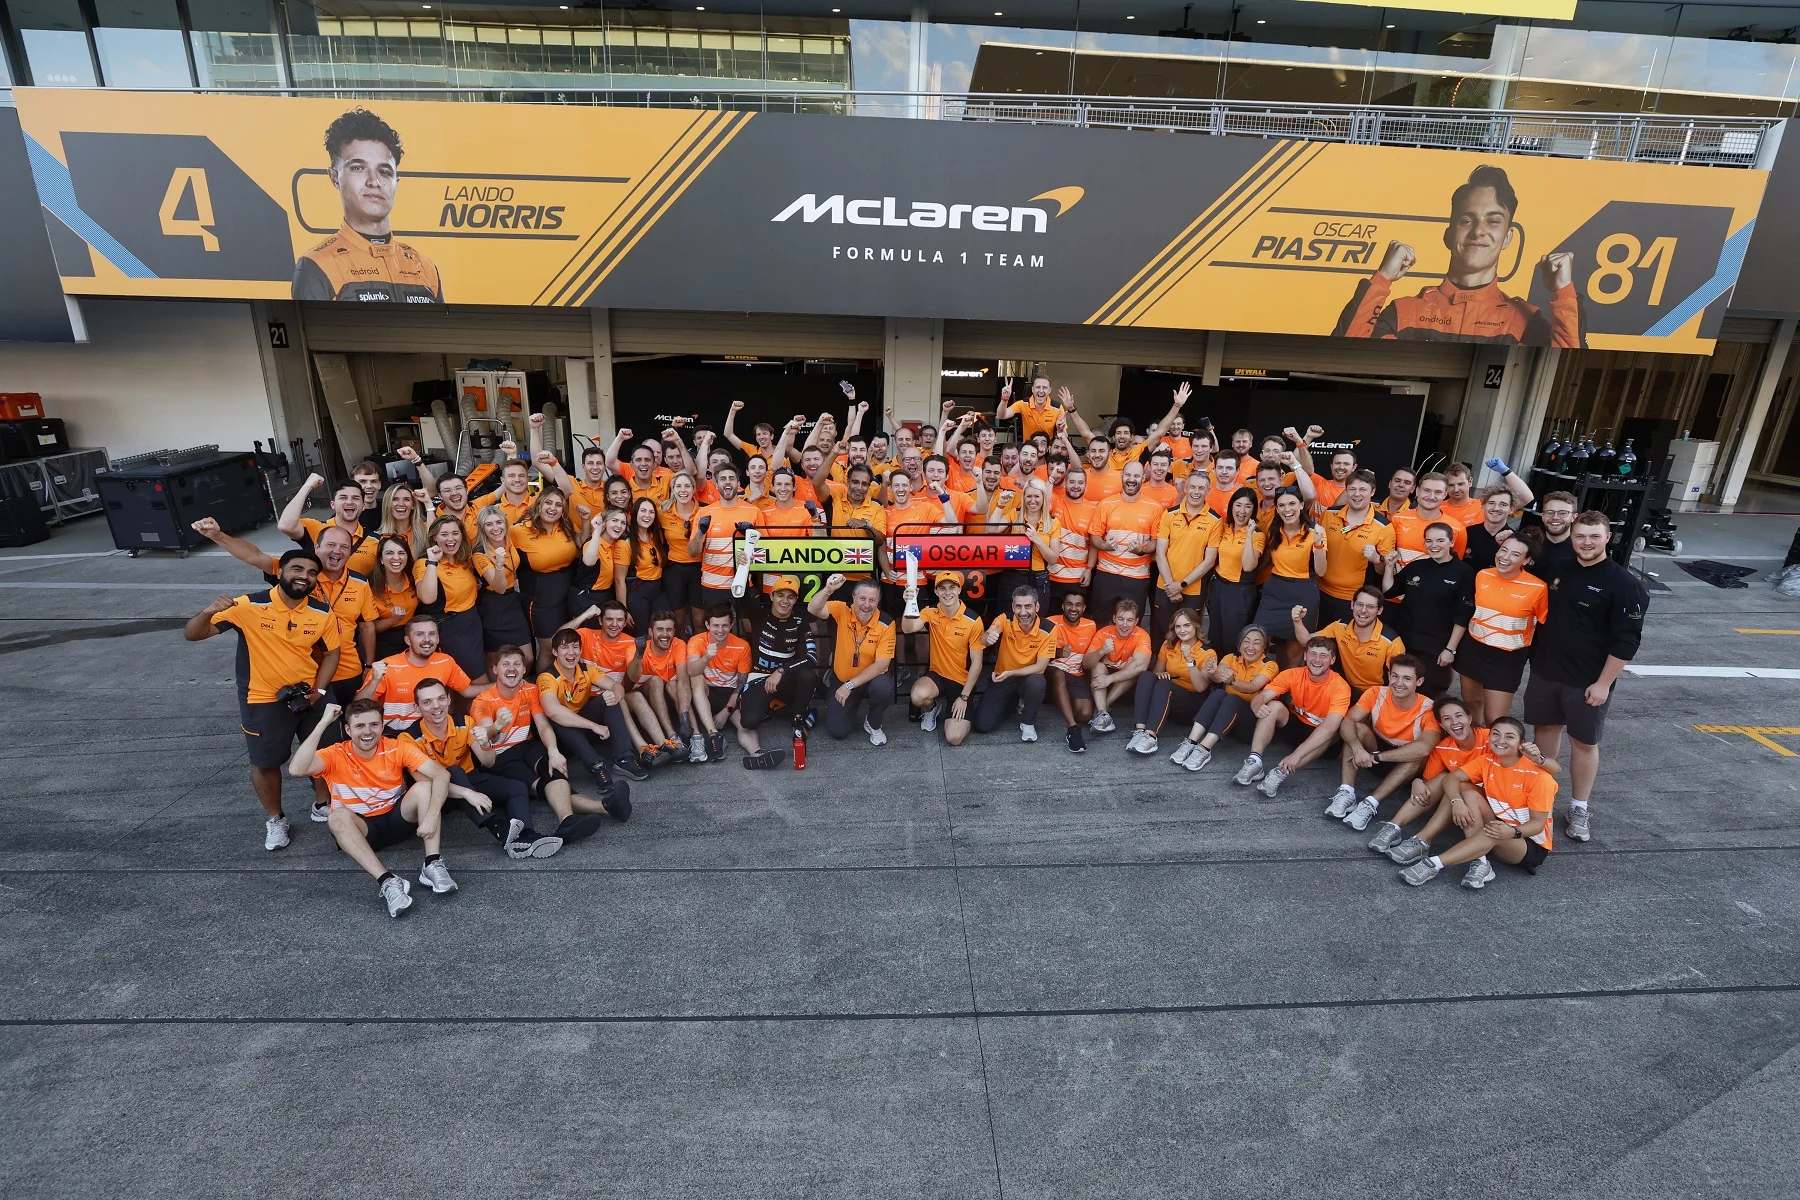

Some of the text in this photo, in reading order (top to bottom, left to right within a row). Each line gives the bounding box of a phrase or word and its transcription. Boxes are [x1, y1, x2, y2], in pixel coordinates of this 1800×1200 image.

[444, 186, 514, 202] LANDO
[159, 168, 220, 251] 4
[439, 203, 565, 229] NORRIS
[771, 193, 1047, 233] McLaren
[1313, 222, 1377, 239] OSCAR
[832, 246, 1044, 267] FORMULA 1 TEAM
[1252, 235, 1377, 264] PIASTRI
[350, 267, 379, 276] android
[1587, 233, 1677, 305] 81
[1419, 315, 1452, 326] android
[271, 327, 286, 345] 21
[1485, 368, 1501, 386] 24
[654, 414, 694, 423] McLen
[765, 547, 844, 564] LANDO
[928, 545, 999, 561] OSCAR
